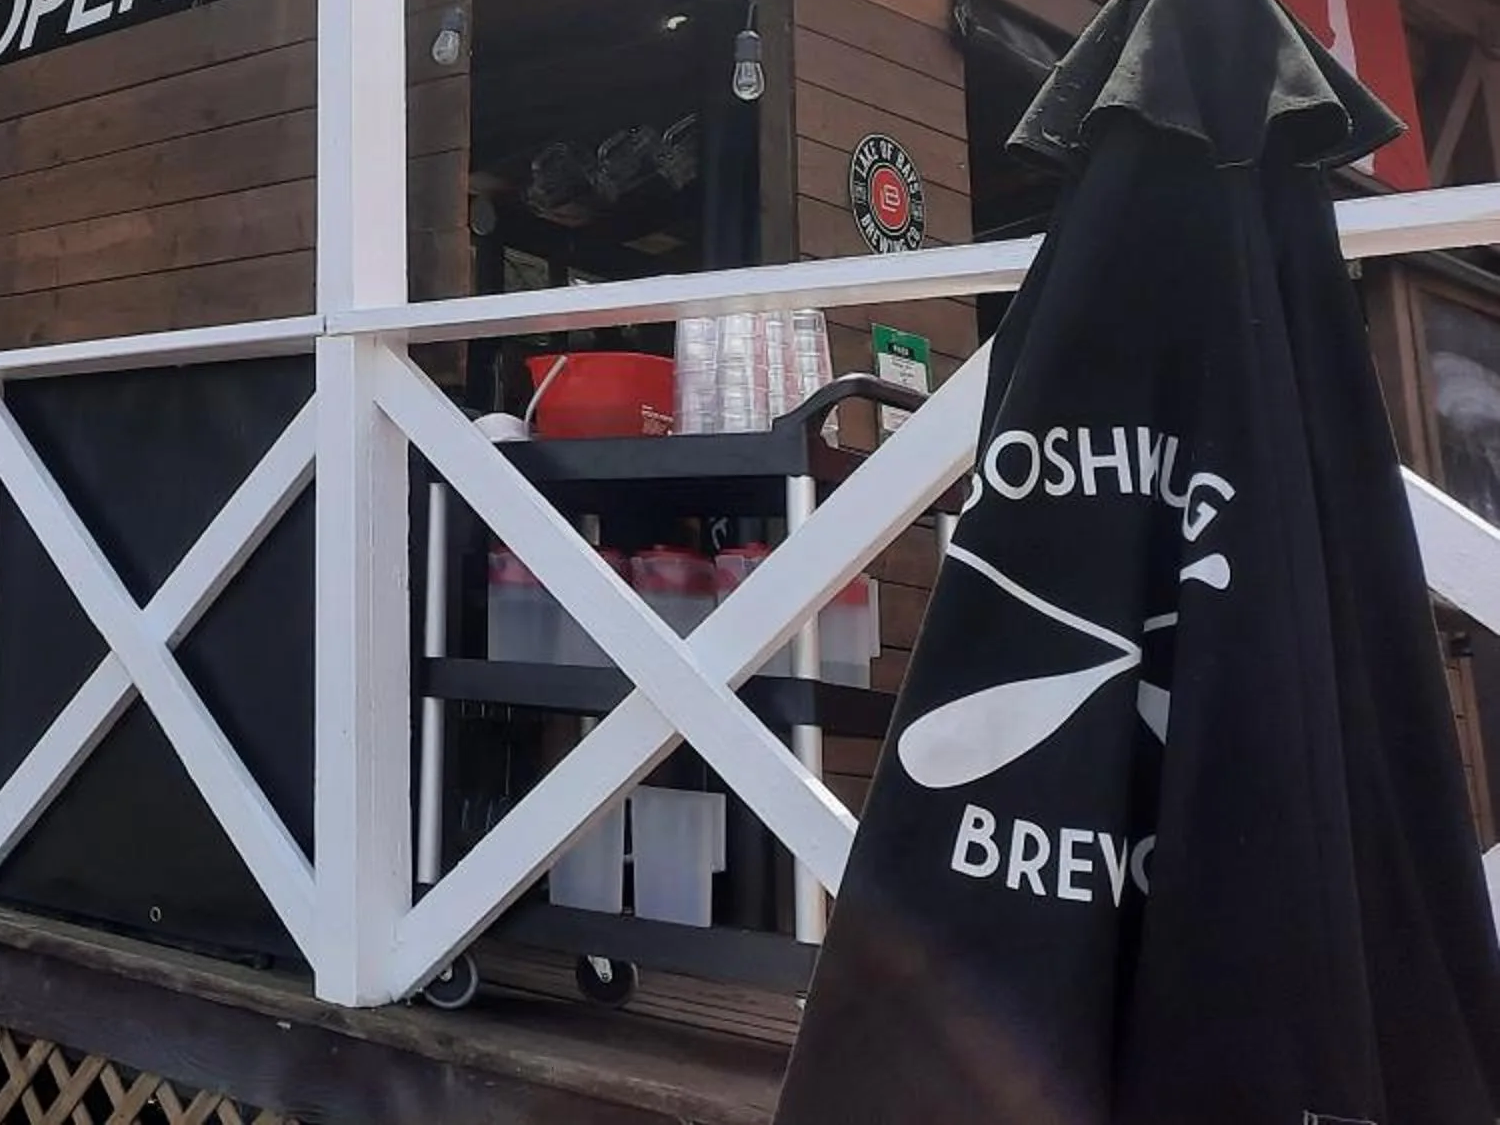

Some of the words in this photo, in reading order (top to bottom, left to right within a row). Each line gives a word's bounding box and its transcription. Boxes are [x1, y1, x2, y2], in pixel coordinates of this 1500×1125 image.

[854, 141, 879, 180] LAKE
[879, 140, 894, 161] OF
[895, 153, 919, 195] BAYS
